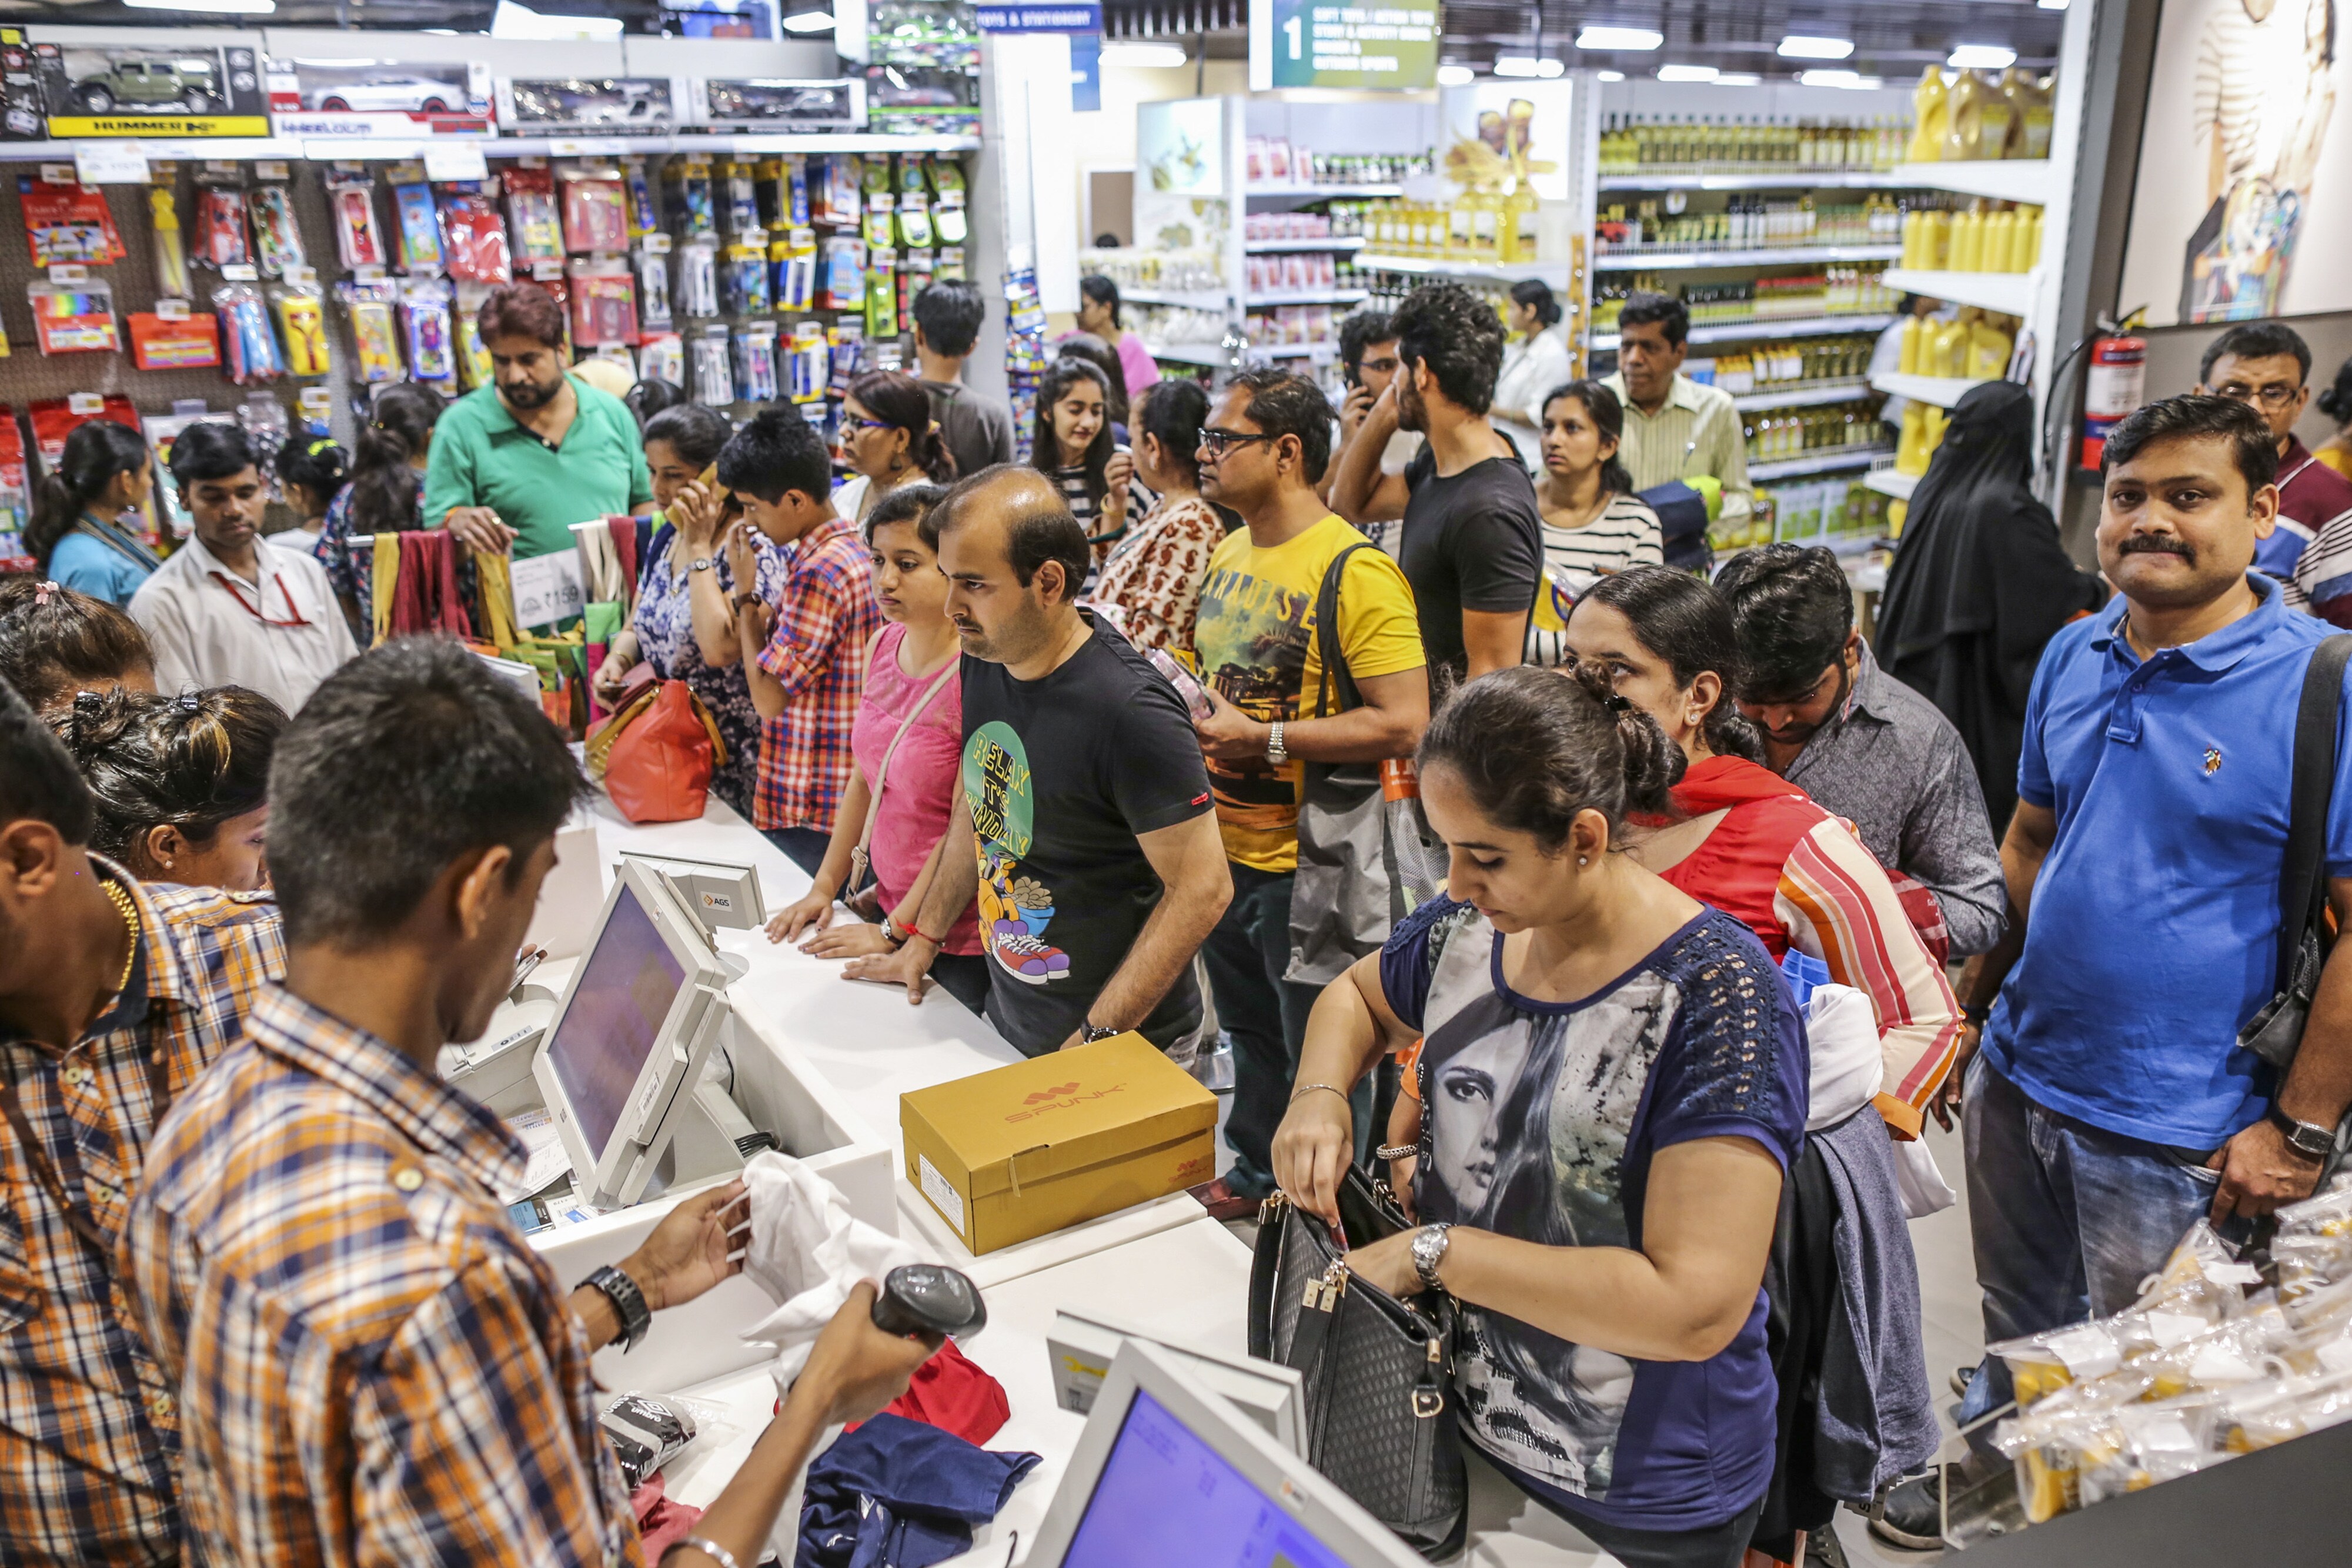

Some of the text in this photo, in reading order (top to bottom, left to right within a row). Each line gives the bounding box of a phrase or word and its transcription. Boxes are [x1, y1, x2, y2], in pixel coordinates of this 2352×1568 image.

[1283, 16, 1302, 59] 1
[93, 122, 182, 131] HUMMER
[544, 584, 579, 609] ₹159
[973, 731, 1030, 797] RELAX
[981, 773, 1010, 818] IT'S
[714, 898, 730, 907] AGS
[1005, 1085, 1124, 1124] SPUNK
[631, 1407, 662, 1423] umbro
